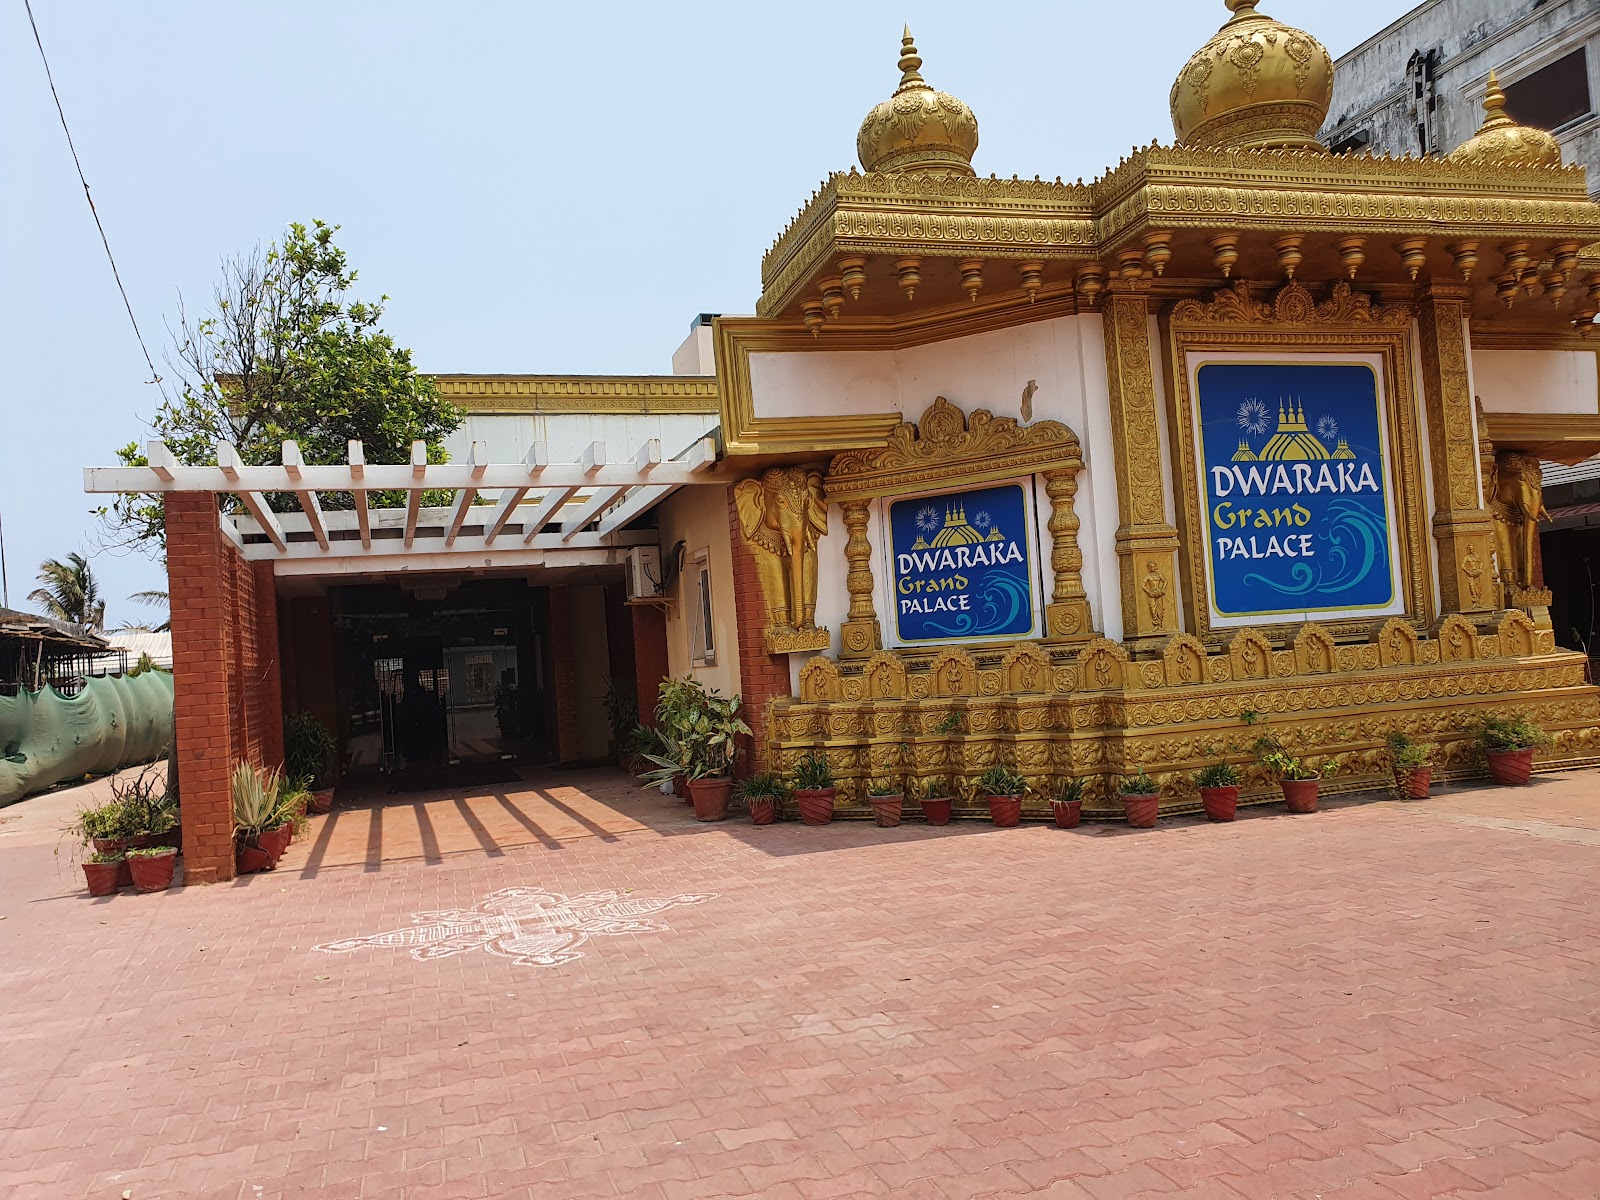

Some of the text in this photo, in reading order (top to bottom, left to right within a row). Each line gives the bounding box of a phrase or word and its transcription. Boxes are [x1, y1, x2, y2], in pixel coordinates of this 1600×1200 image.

[1210, 462, 1379, 497] DWARAKA
[1213, 502, 1311, 529] Grand
[897, 541, 1024, 574] DWARAKA
[1216, 534, 1315, 560] PALACE
[898, 574, 969, 595] Grand
[900, 595, 971, 614] PALACE
